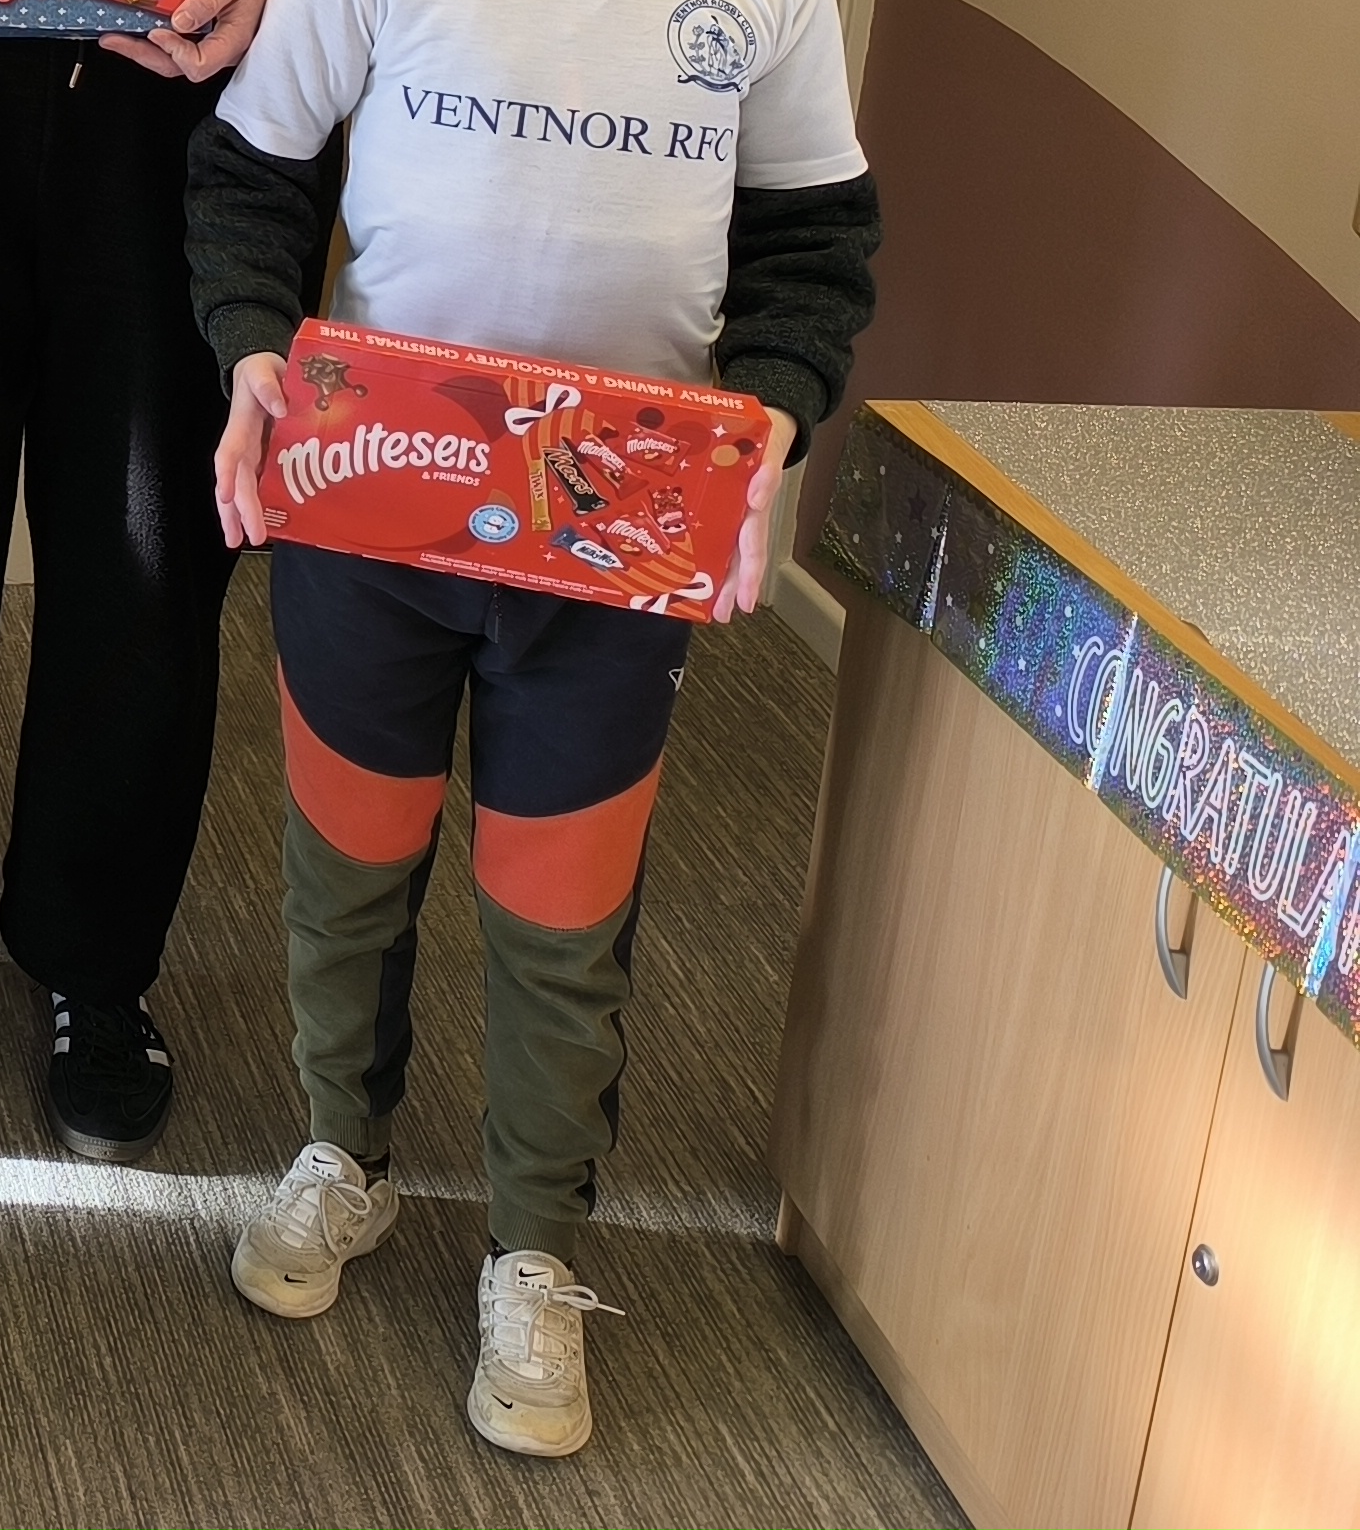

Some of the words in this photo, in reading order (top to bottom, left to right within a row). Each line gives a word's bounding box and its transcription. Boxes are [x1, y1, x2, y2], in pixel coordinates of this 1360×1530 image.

[673, 0, 709, 23] VENTNOR
[711, 0, 742, 18] RUGBY
[742, 19, 755, 46] CLUB
[402, 85, 653, 155] VENTNOR
[664, 122, 734, 161] RFC
[319, 326, 361, 343] TIME
[365, 335, 460, 360] CHRISTMAS
[465, 352, 580, 382] CHOCOLATEY
[585, 373, 598, 385] A
[603, 377, 674, 397] HAVING
[679, 389, 745, 410] SIMPLY
[577, 440, 625, 471] Maltesers
[627, 438, 678, 453] Maltesers
[277, 423, 491, 505] Maltesers
[544, 447, 594, 495] Mars
[421, 471, 430, 481] &
[432, 471, 482, 488] FRIENDS
